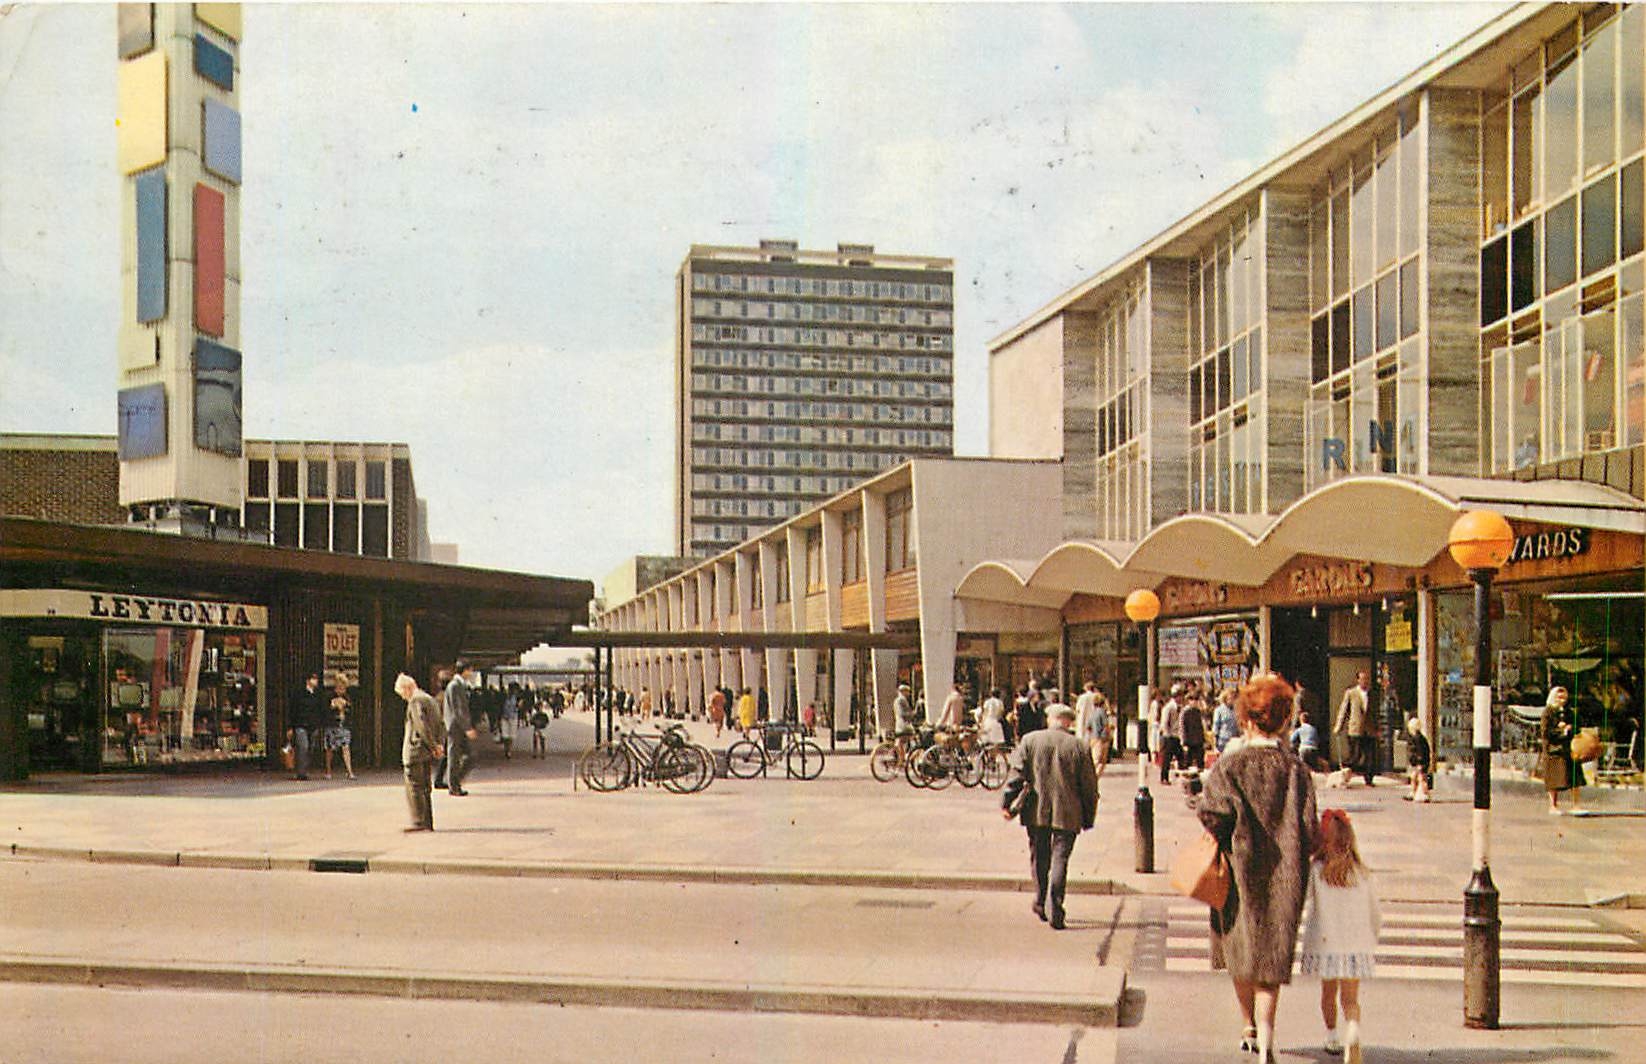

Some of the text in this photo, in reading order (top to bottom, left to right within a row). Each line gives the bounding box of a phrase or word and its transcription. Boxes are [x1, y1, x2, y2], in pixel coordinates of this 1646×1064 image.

[1510, 528, 1582, 561] ARDS
[89, 595, 251, 626] LEYTONIA
[326, 633, 357, 651] TO LET
